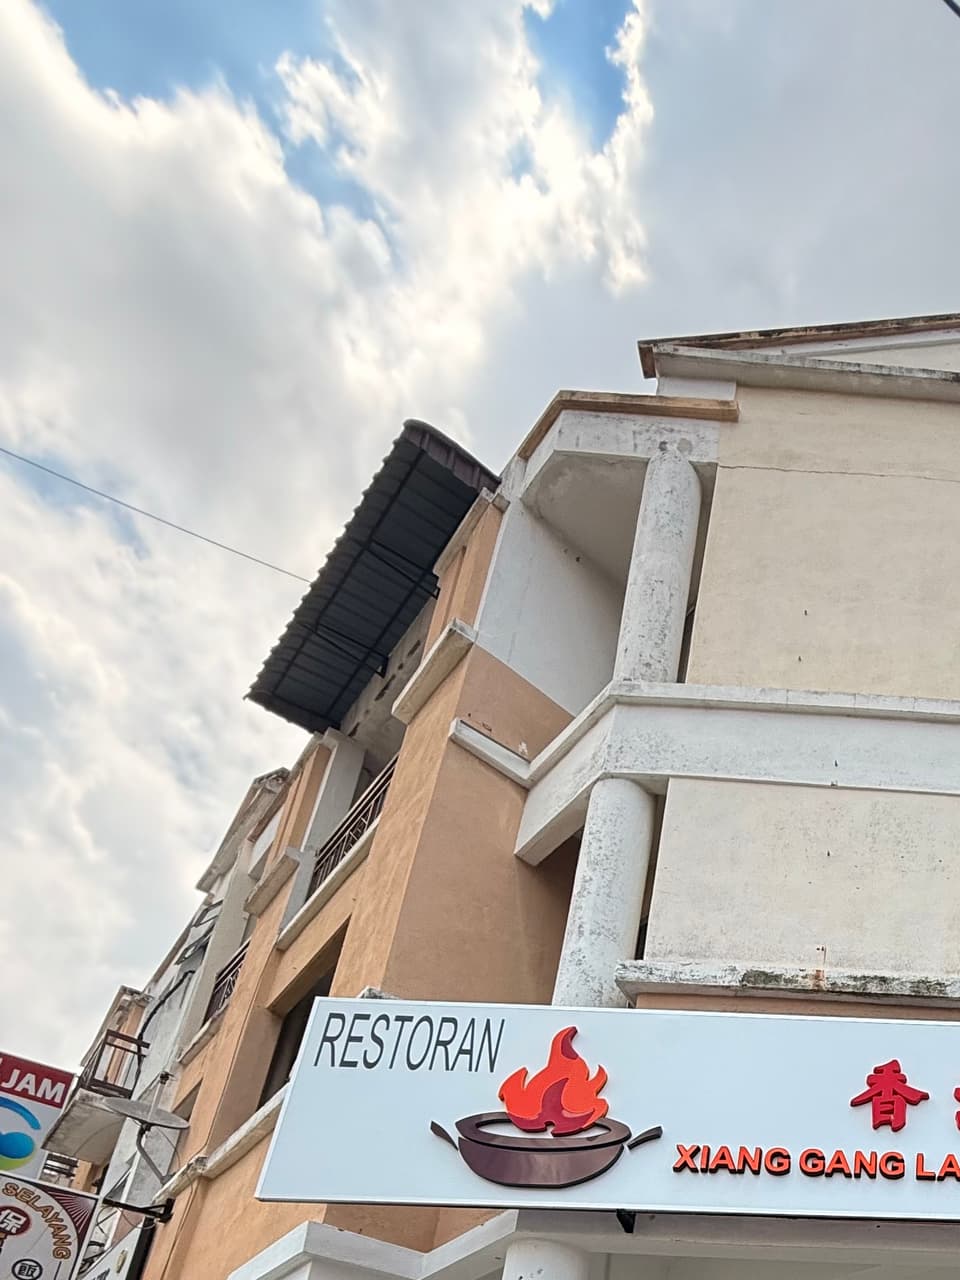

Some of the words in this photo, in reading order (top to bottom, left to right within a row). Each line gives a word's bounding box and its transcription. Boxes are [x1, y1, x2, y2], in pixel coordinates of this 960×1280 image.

[314, 1012, 505, 1073] RESTORAN
[1, 1068, 66, 1103] JAM
[673, 1144, 791, 1176] XIANG
[798, 1148, 905, 1180] GANG
[2, 1182, 72, 1260] SELAYANG
